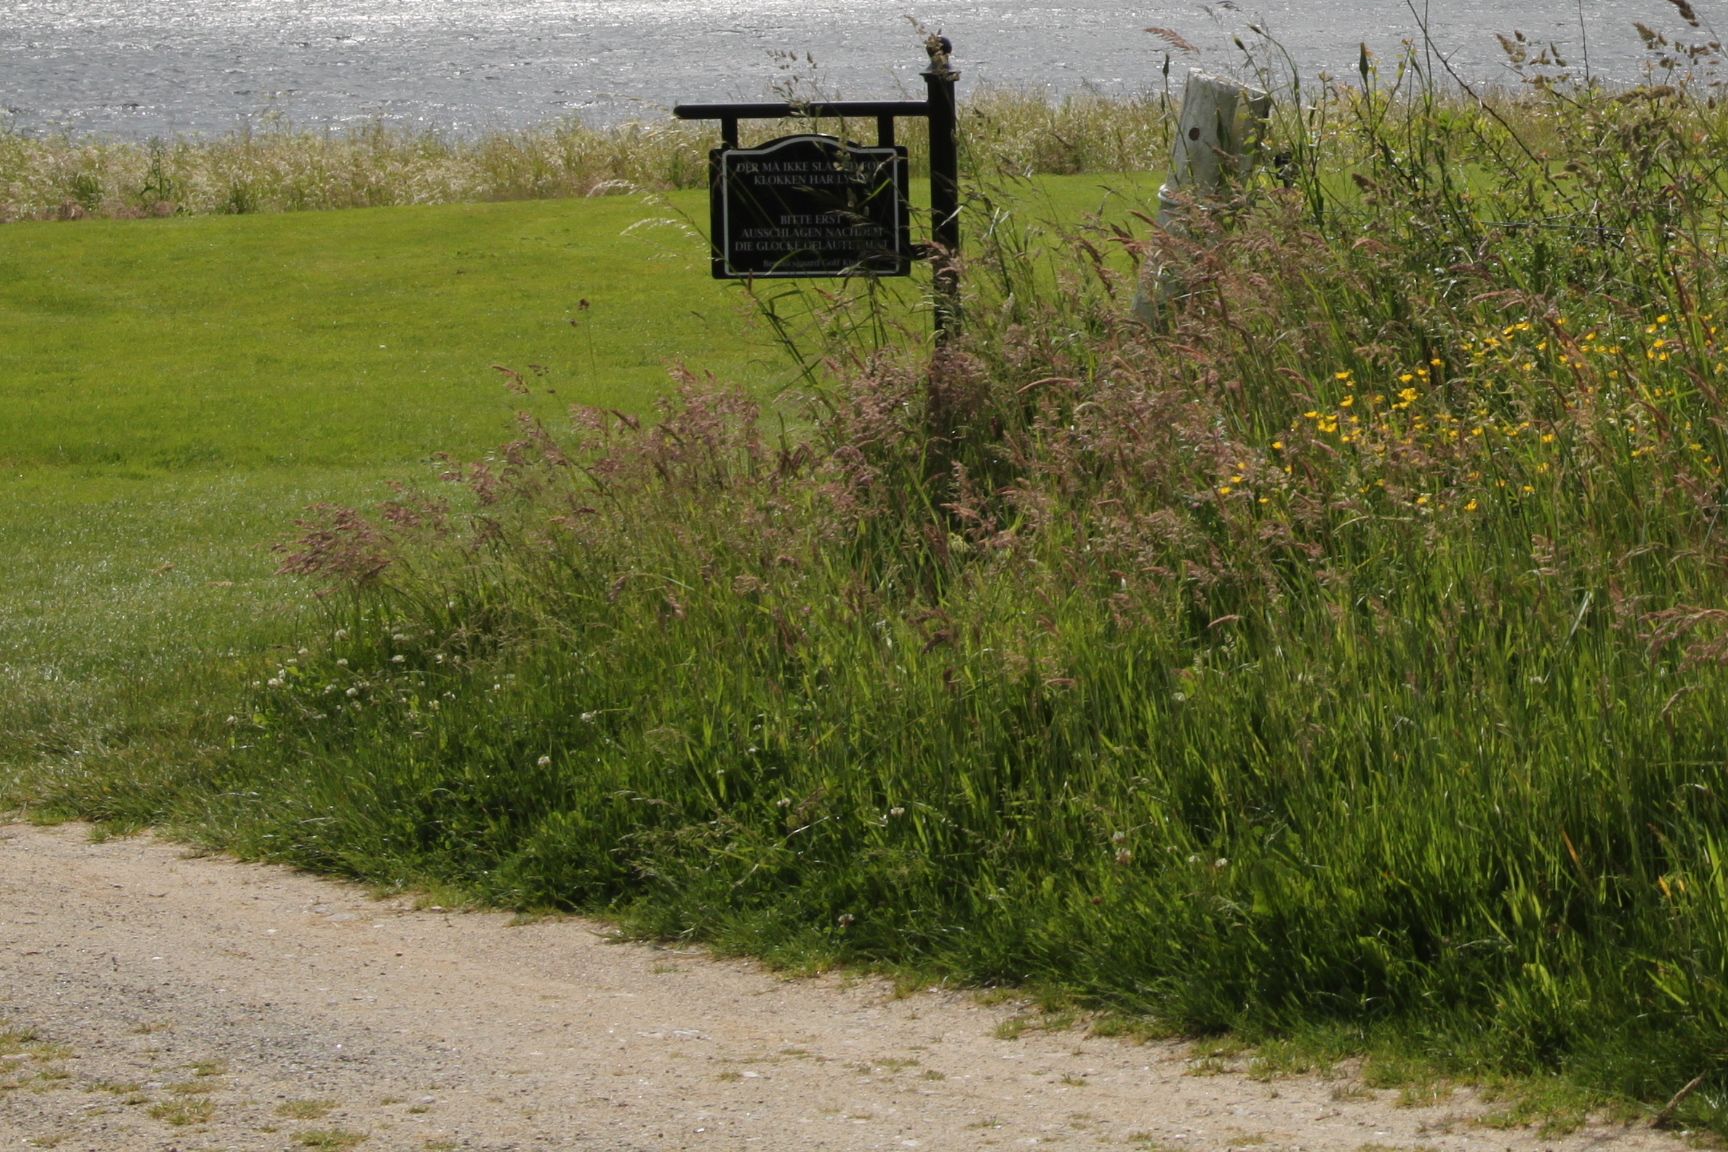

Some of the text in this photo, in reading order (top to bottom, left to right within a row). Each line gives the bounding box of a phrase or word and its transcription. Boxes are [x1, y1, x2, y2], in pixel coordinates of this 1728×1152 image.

[735, 162, 759, 173] DER
[783, 161, 808, 172] IKKE
[753, 174, 806, 185] KLOKKEN
[809, 174, 834, 185] HAR
[780, 214, 841, 225] BITTE ERST
[742, 227, 822, 238] AUSSCHLAGEN
[735, 241, 752, 252] DIE
[756, 240, 801, 251] GLOCKE
